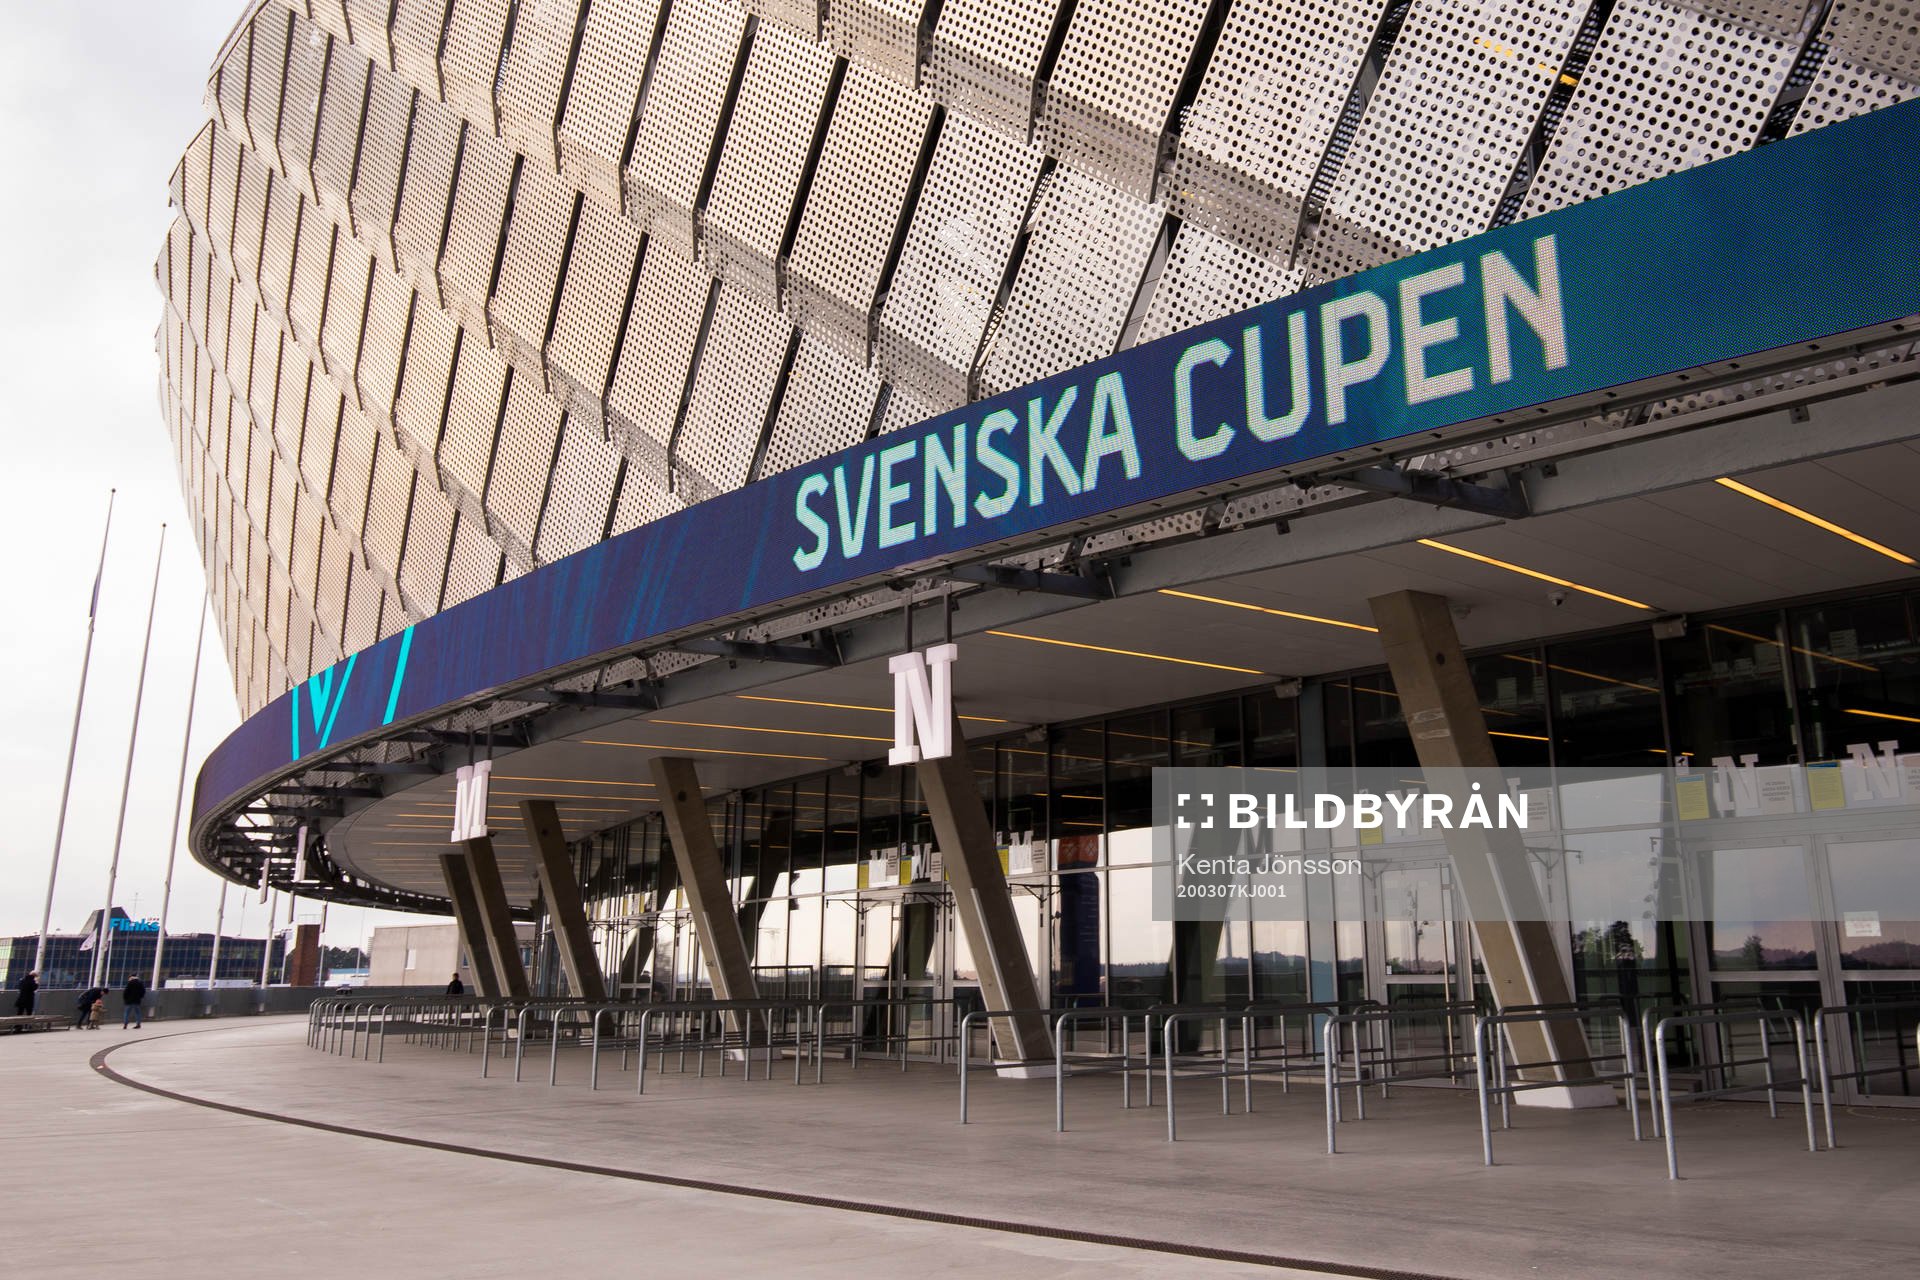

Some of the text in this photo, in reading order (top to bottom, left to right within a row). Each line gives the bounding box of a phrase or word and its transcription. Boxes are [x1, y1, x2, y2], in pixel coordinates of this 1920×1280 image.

[792, 234, 1568, 573] SVENSKA CUPEN
[888, 643, 958, 766] N
